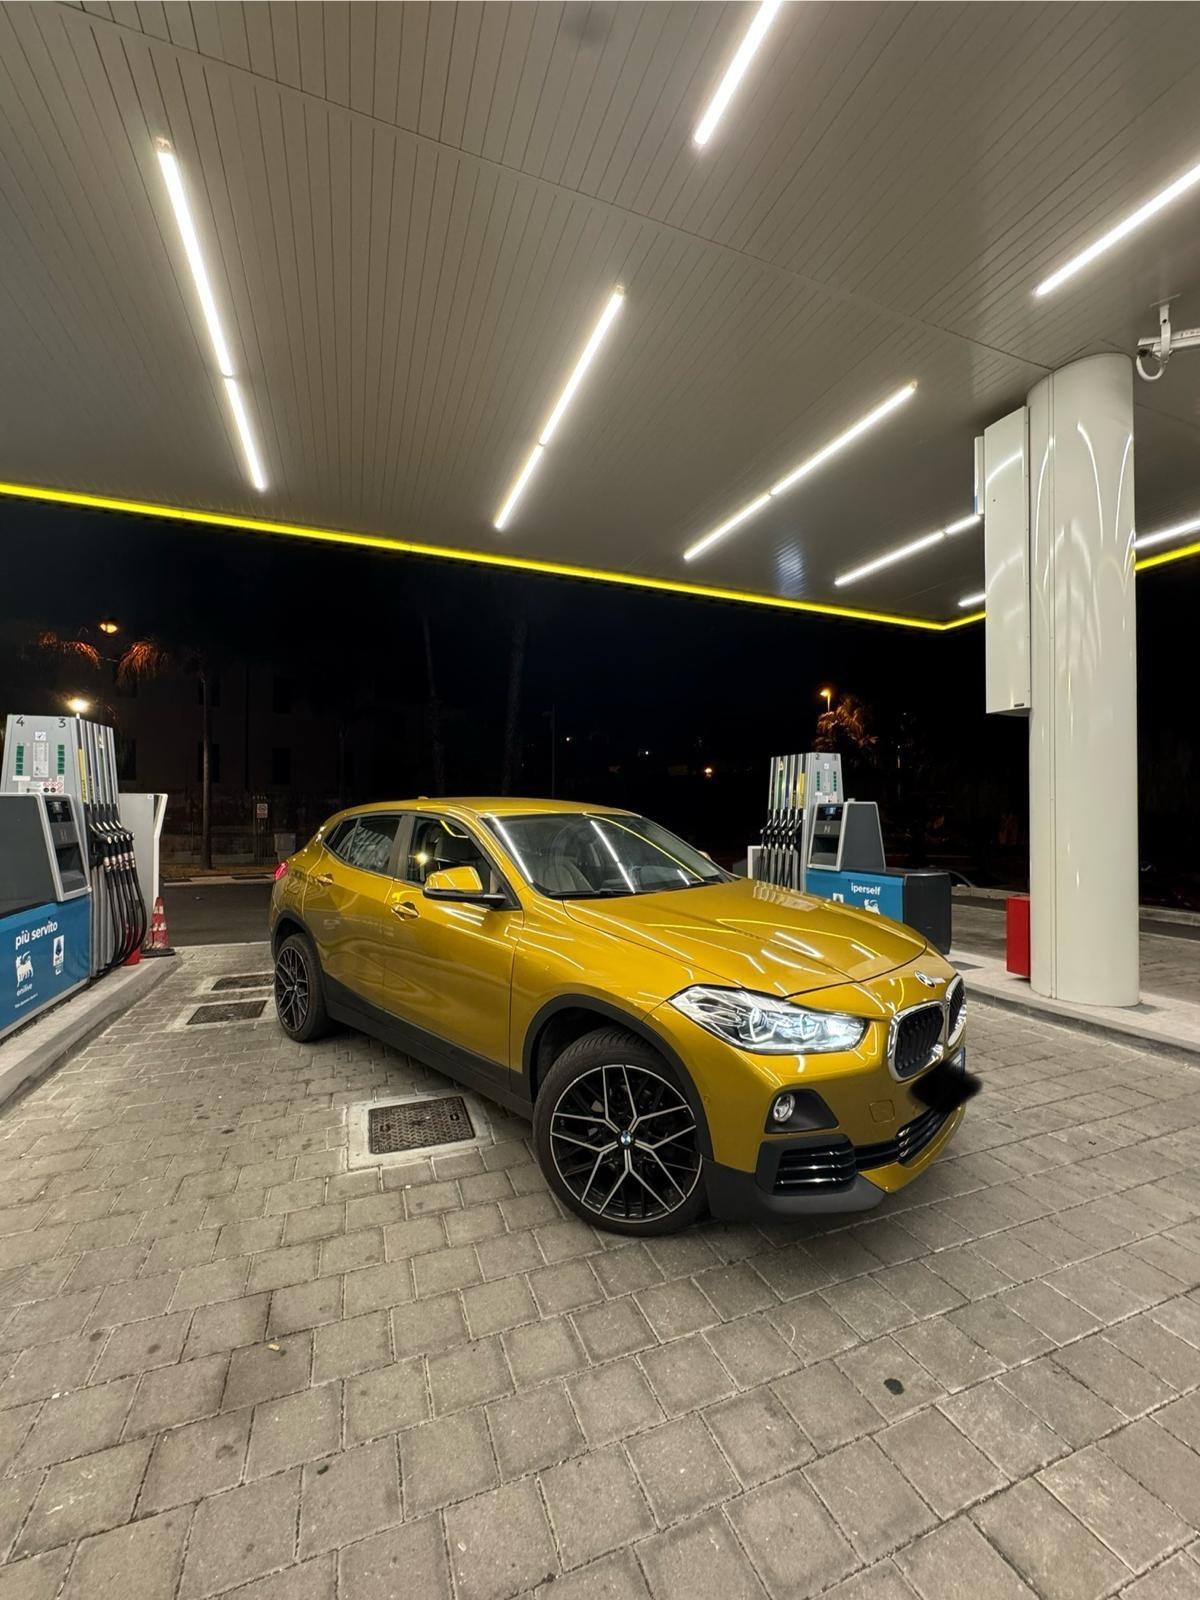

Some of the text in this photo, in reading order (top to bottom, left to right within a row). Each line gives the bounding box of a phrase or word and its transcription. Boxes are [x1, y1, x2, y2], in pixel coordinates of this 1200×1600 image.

[16, 716, 25, 728] 4
[58, 718, 66, 729] 3
[15, 920, 58, 950] più servito
